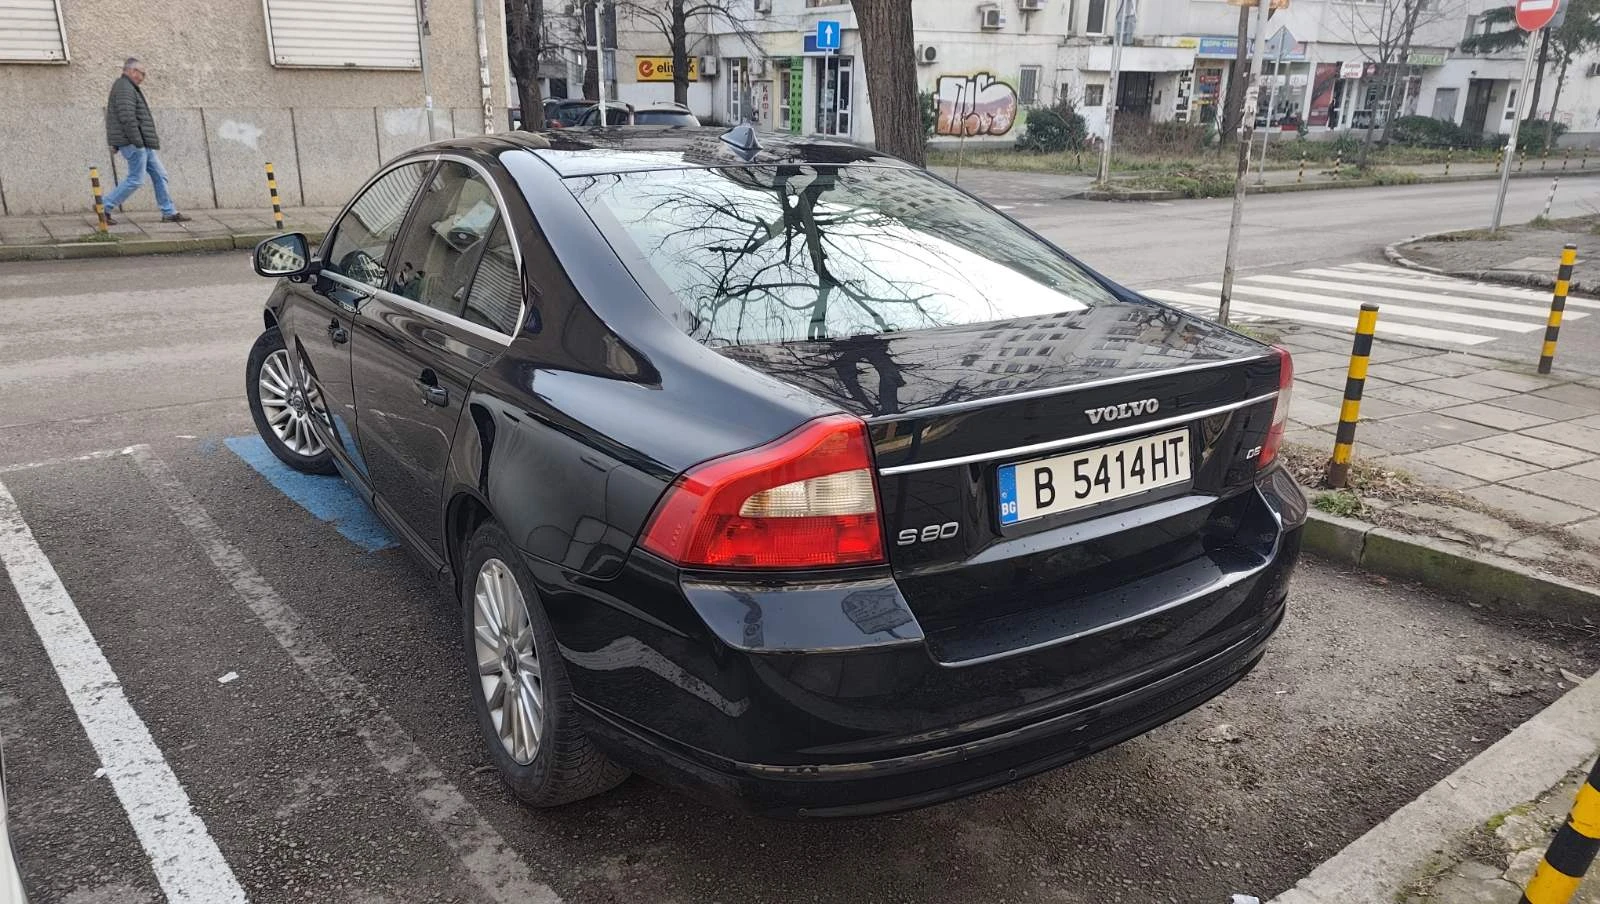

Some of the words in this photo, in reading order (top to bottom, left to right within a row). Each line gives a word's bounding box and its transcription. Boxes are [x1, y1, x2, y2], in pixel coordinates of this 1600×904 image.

[1084, 398, 1160, 425] VOLVO
[1001, 501, 1018, 515] BG
[1034, 466, 1057, 510] B
